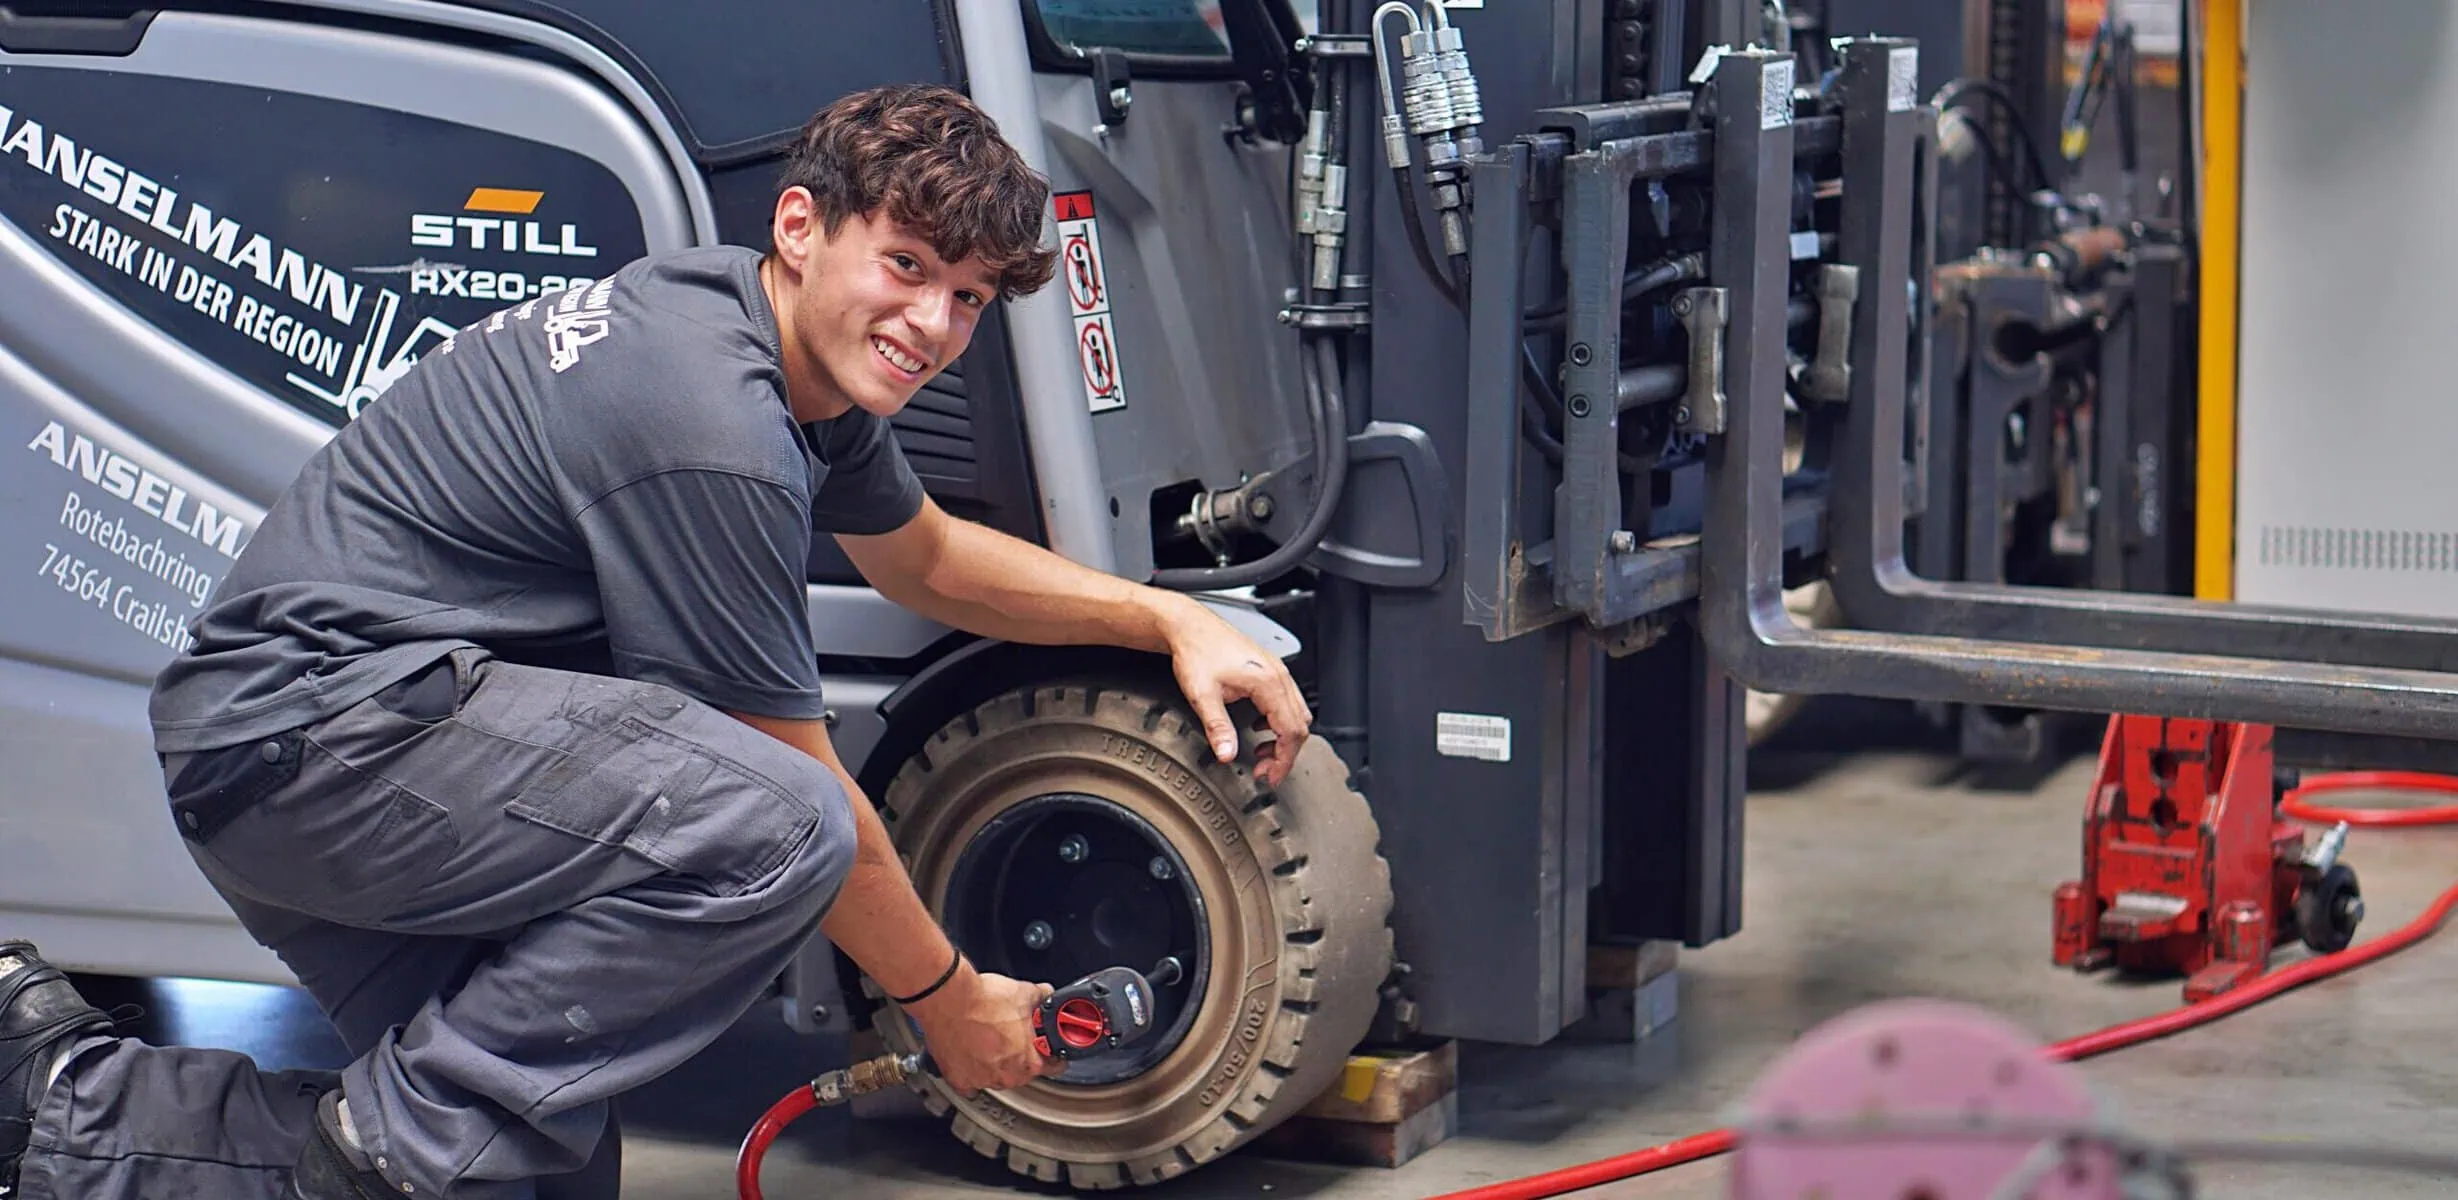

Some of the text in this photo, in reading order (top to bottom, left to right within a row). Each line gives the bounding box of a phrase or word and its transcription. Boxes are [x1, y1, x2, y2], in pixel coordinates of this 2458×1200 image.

[50, 203, 344, 378] STARK IN DER REGION
[411, 213, 598, 257] STILL
[27, 420, 250, 560] ANSELM
[37, 544, 194, 654] 74564 Crailsh
[60, 491, 213, 610] Rotebachring
[1101, 732, 1241, 848] TRELLEBORG
[1200, 998, 1268, 1108] 200/50-10
